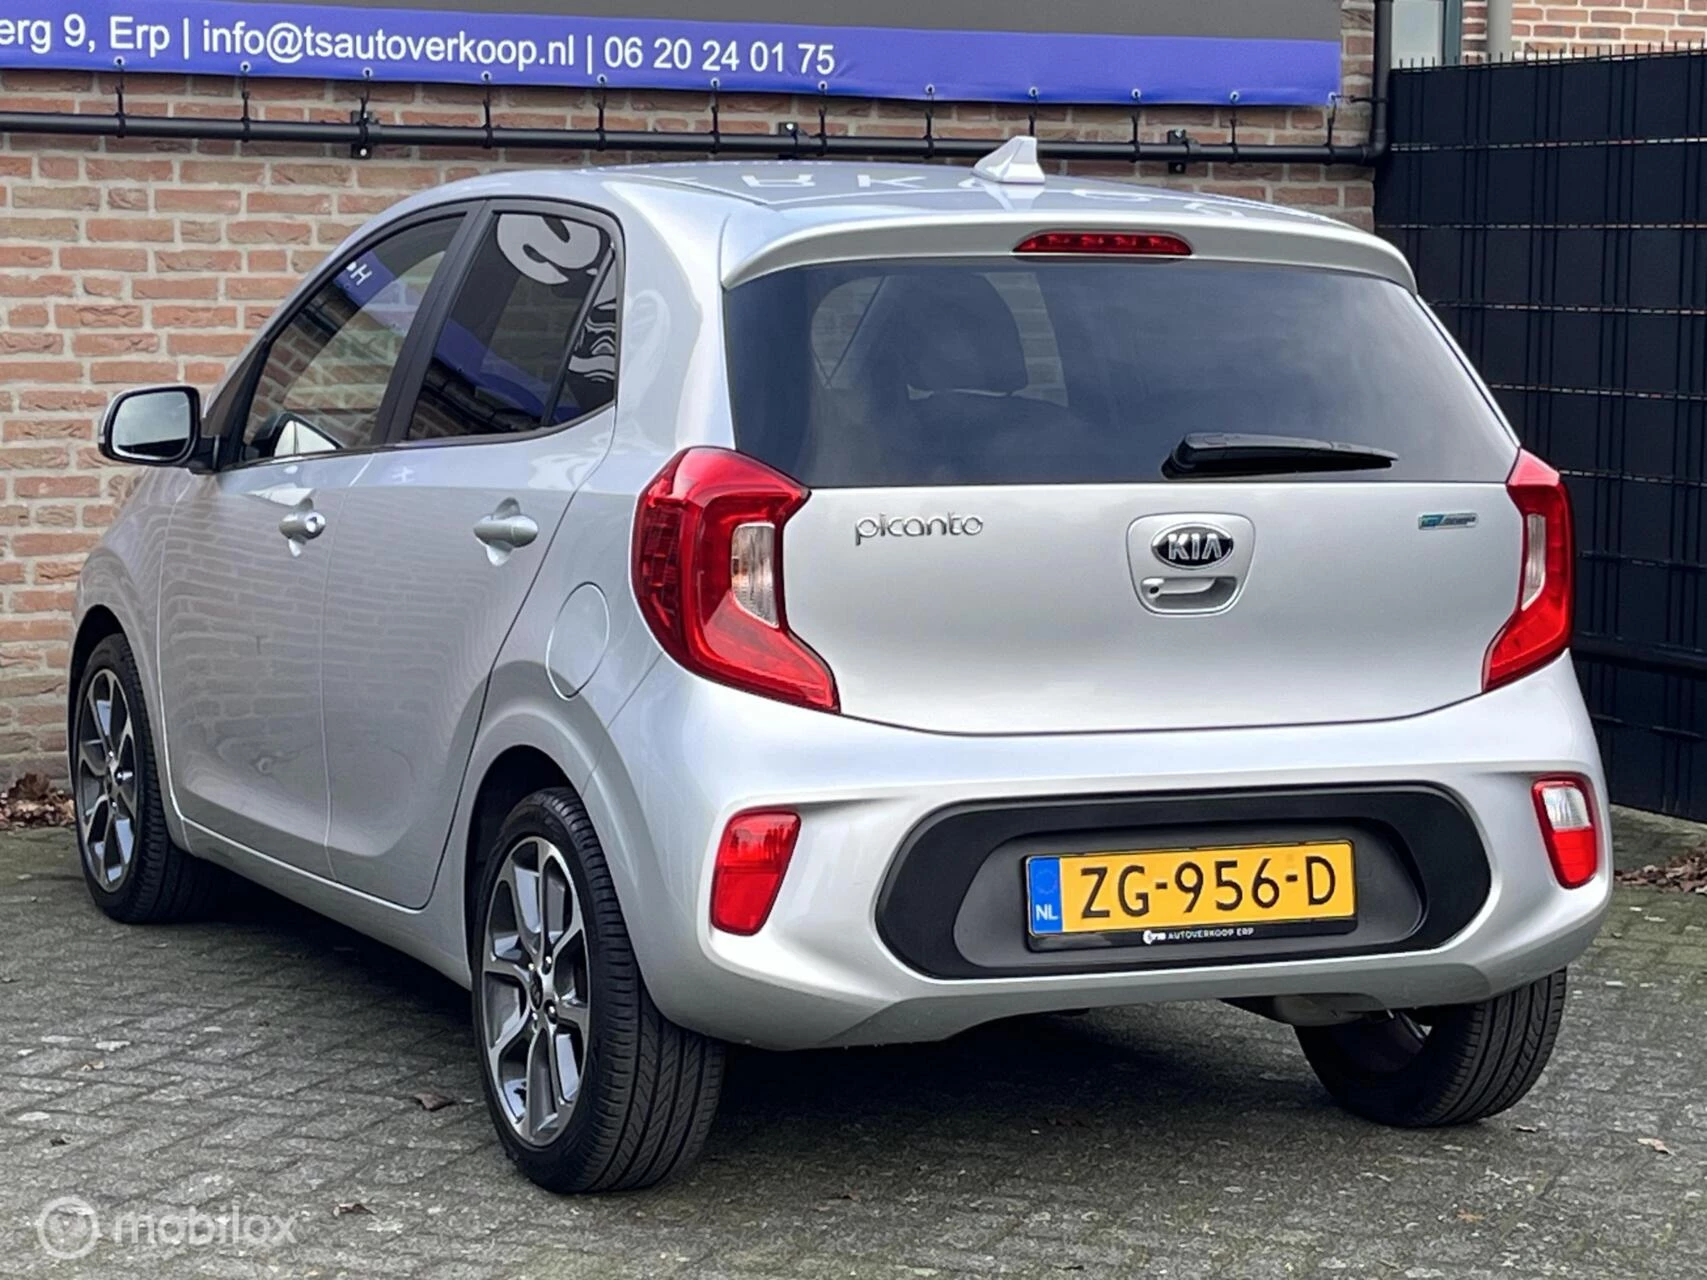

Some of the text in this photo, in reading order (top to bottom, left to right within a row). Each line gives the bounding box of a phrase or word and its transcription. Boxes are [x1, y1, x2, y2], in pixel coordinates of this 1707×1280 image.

[0, 19, 51, 54] erg
[63, 13, 96, 53] 9,
[109, 15, 171, 58] Erp
[202, 19, 575, 72] info@tsautoverkoop.nl
[604, 36, 644, 68] 06
[653, 37, 692, 70] 20
[702, 40, 740, 72] 24
[750, 42, 784, 73] 01
[797, 43, 835, 75] 75
[855, 511, 984, 546] picanto
[1167, 532, 1222, 560] KIA
[1080, 855, 1336, 919] ZG-956-D
[1035, 904, 1059, 921] NL
